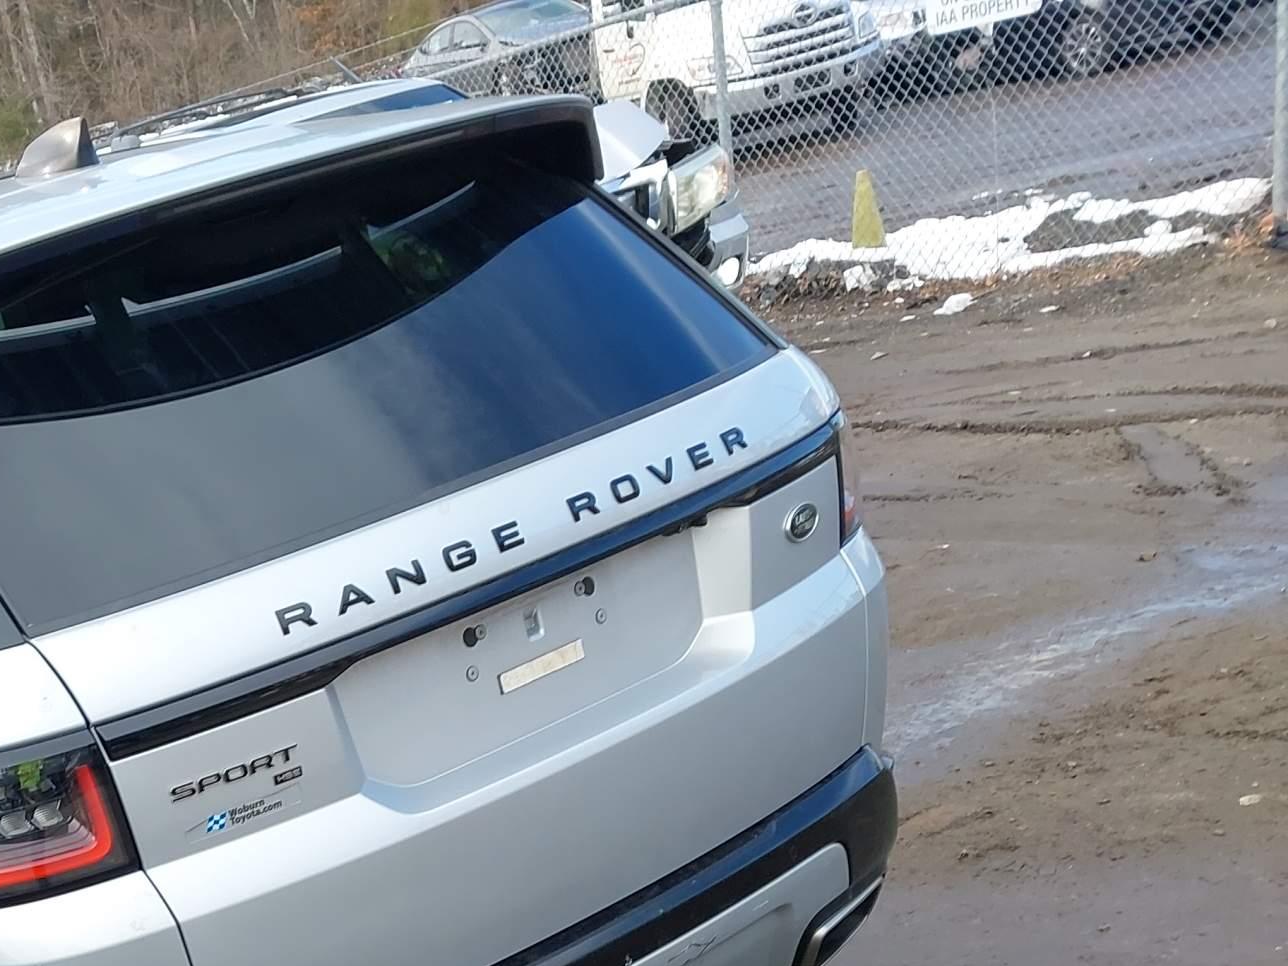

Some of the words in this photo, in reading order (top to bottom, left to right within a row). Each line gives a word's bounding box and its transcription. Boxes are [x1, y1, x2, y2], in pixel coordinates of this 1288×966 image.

[936, 9, 958, 27] IAA
[274, 519, 525, 636] RANGE
[565, 426, 749, 523] ROVER
[169, 743, 298, 803] SPORT
[228, 799, 265, 817] Woburn
[230, 800, 283, 826] Toyota.com
